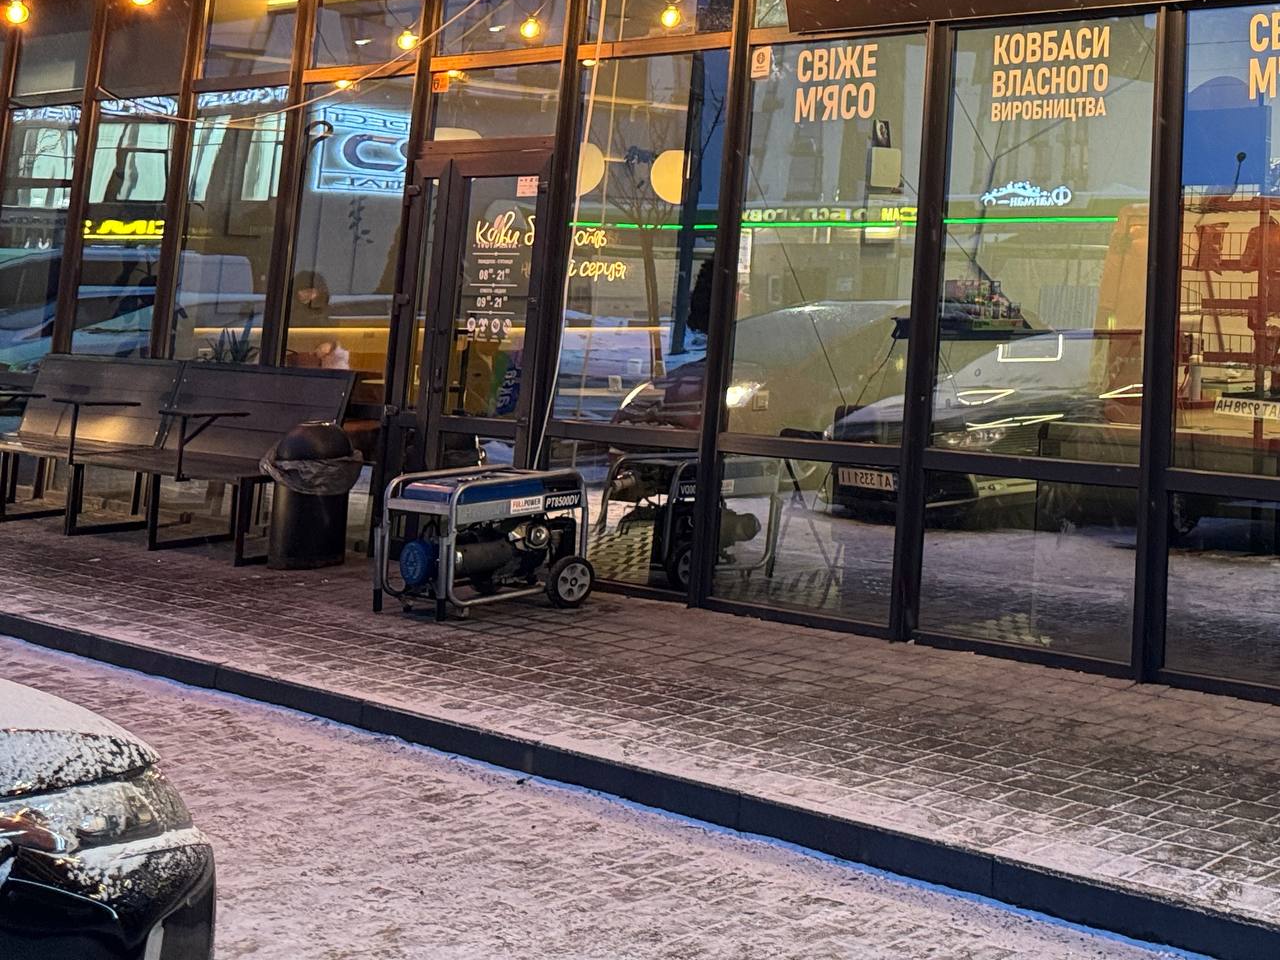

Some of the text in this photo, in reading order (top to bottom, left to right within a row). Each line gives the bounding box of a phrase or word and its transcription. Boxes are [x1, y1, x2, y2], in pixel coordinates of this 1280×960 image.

[797, 44, 878, 84] СВІЖЕ
[993, 26, 1110, 66] КОВБАСИ
[991, 63, 1108, 98] ВЛАСНОГО
[794, 82, 876, 123] М'ЯСО
[991, 96, 1106, 122] ВИРОБНИЦТВА
